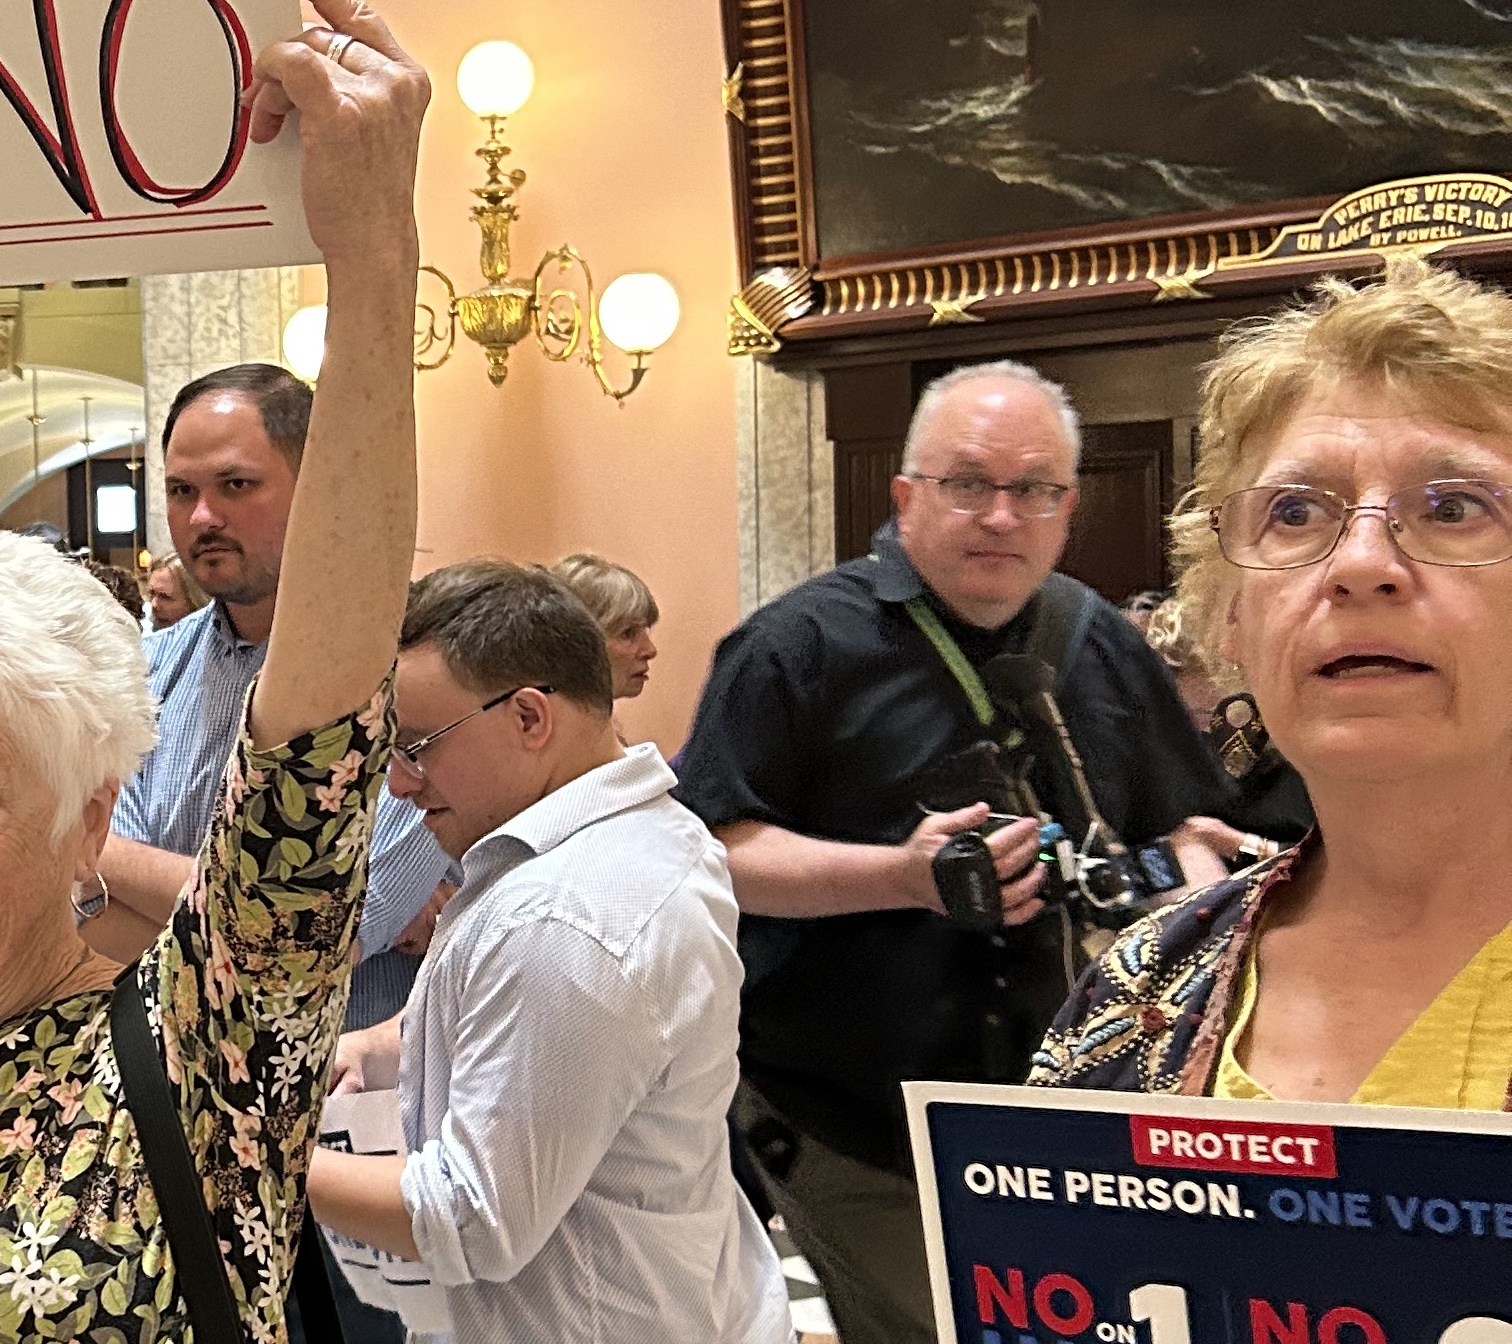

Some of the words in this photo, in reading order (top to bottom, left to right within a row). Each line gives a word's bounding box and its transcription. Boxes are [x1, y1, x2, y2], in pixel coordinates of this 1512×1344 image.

[1334, 187, 1418, 226] PERRY'S
[1424, 182, 1512, 208] VICTORY
[1297, 233, 1322, 252] ON
[1327, 216, 1373, 251] LAKE
[1369, 232, 1392, 248] BY
[1396, 225, 1461, 245] POWELL.
[1148, 1127, 1321, 1166] PROTECT
[963, 1162, 1052, 1202] ONE
[1063, 1171, 1255, 1219] PERSON.
[1269, 1187, 1374, 1229] ONE
[1386, 1195, 1512, 1239] VOTE
[973, 1263, 1094, 1336] NO
